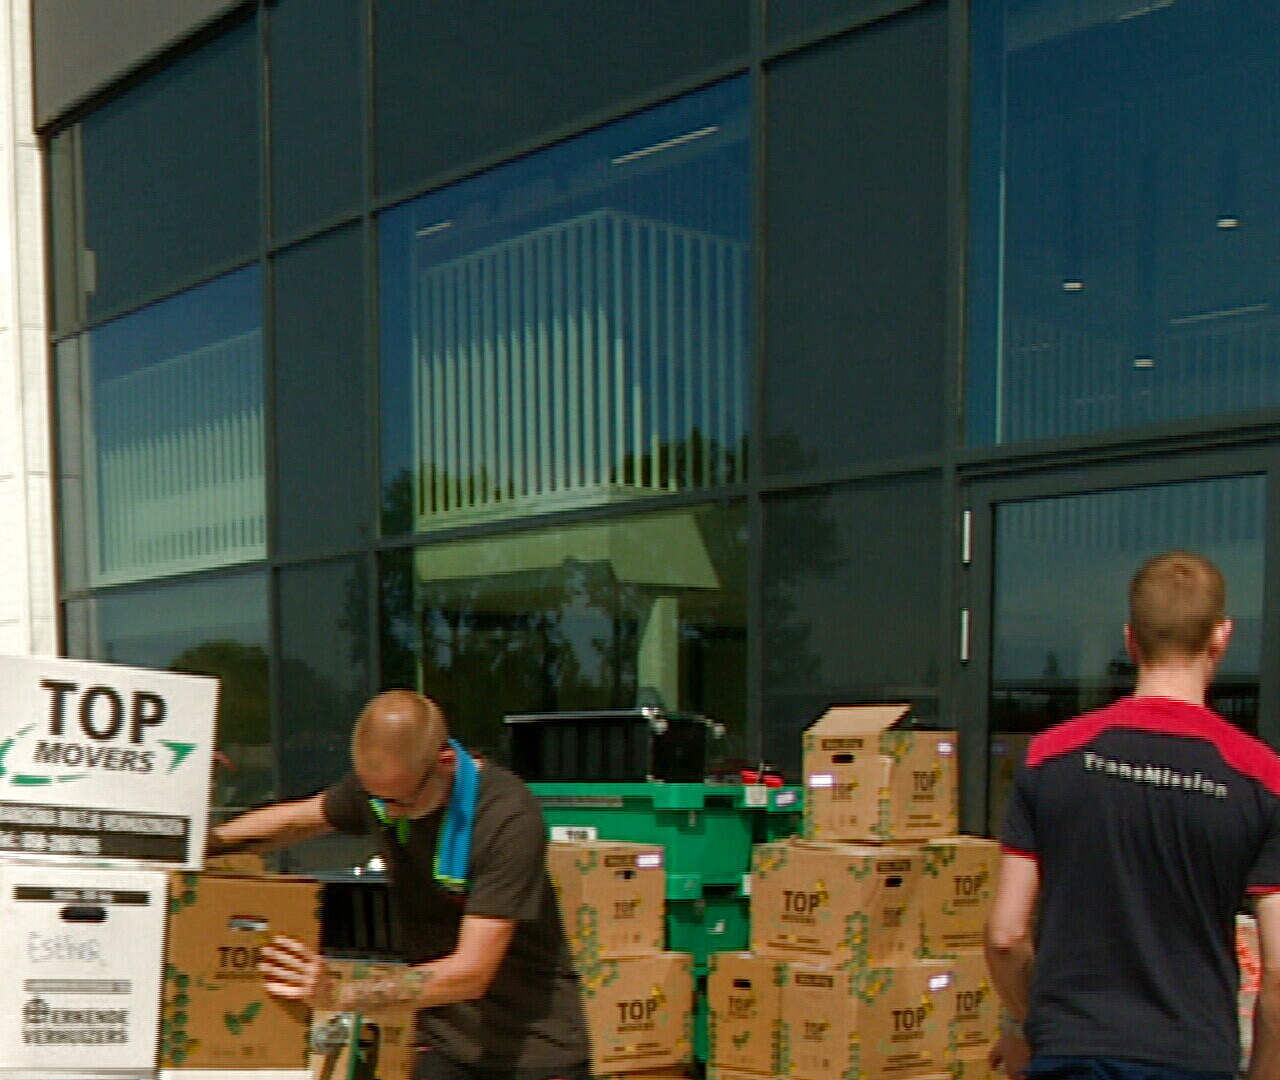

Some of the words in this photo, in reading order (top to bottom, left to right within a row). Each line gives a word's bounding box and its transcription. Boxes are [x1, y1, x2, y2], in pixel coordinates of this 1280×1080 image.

[40, 679, 167, 744] TOP
[33, 741, 155, 773] MOVERS
[1083, 751, 1228, 798] TransMission
[954, 876, 983, 895] TOP
[783, 891, 820, 912] TOP
[616, 999, 656, 1022] TOP
[956, 991, 984, 1011] TOP
[892, 1007, 926, 1031] TOP
